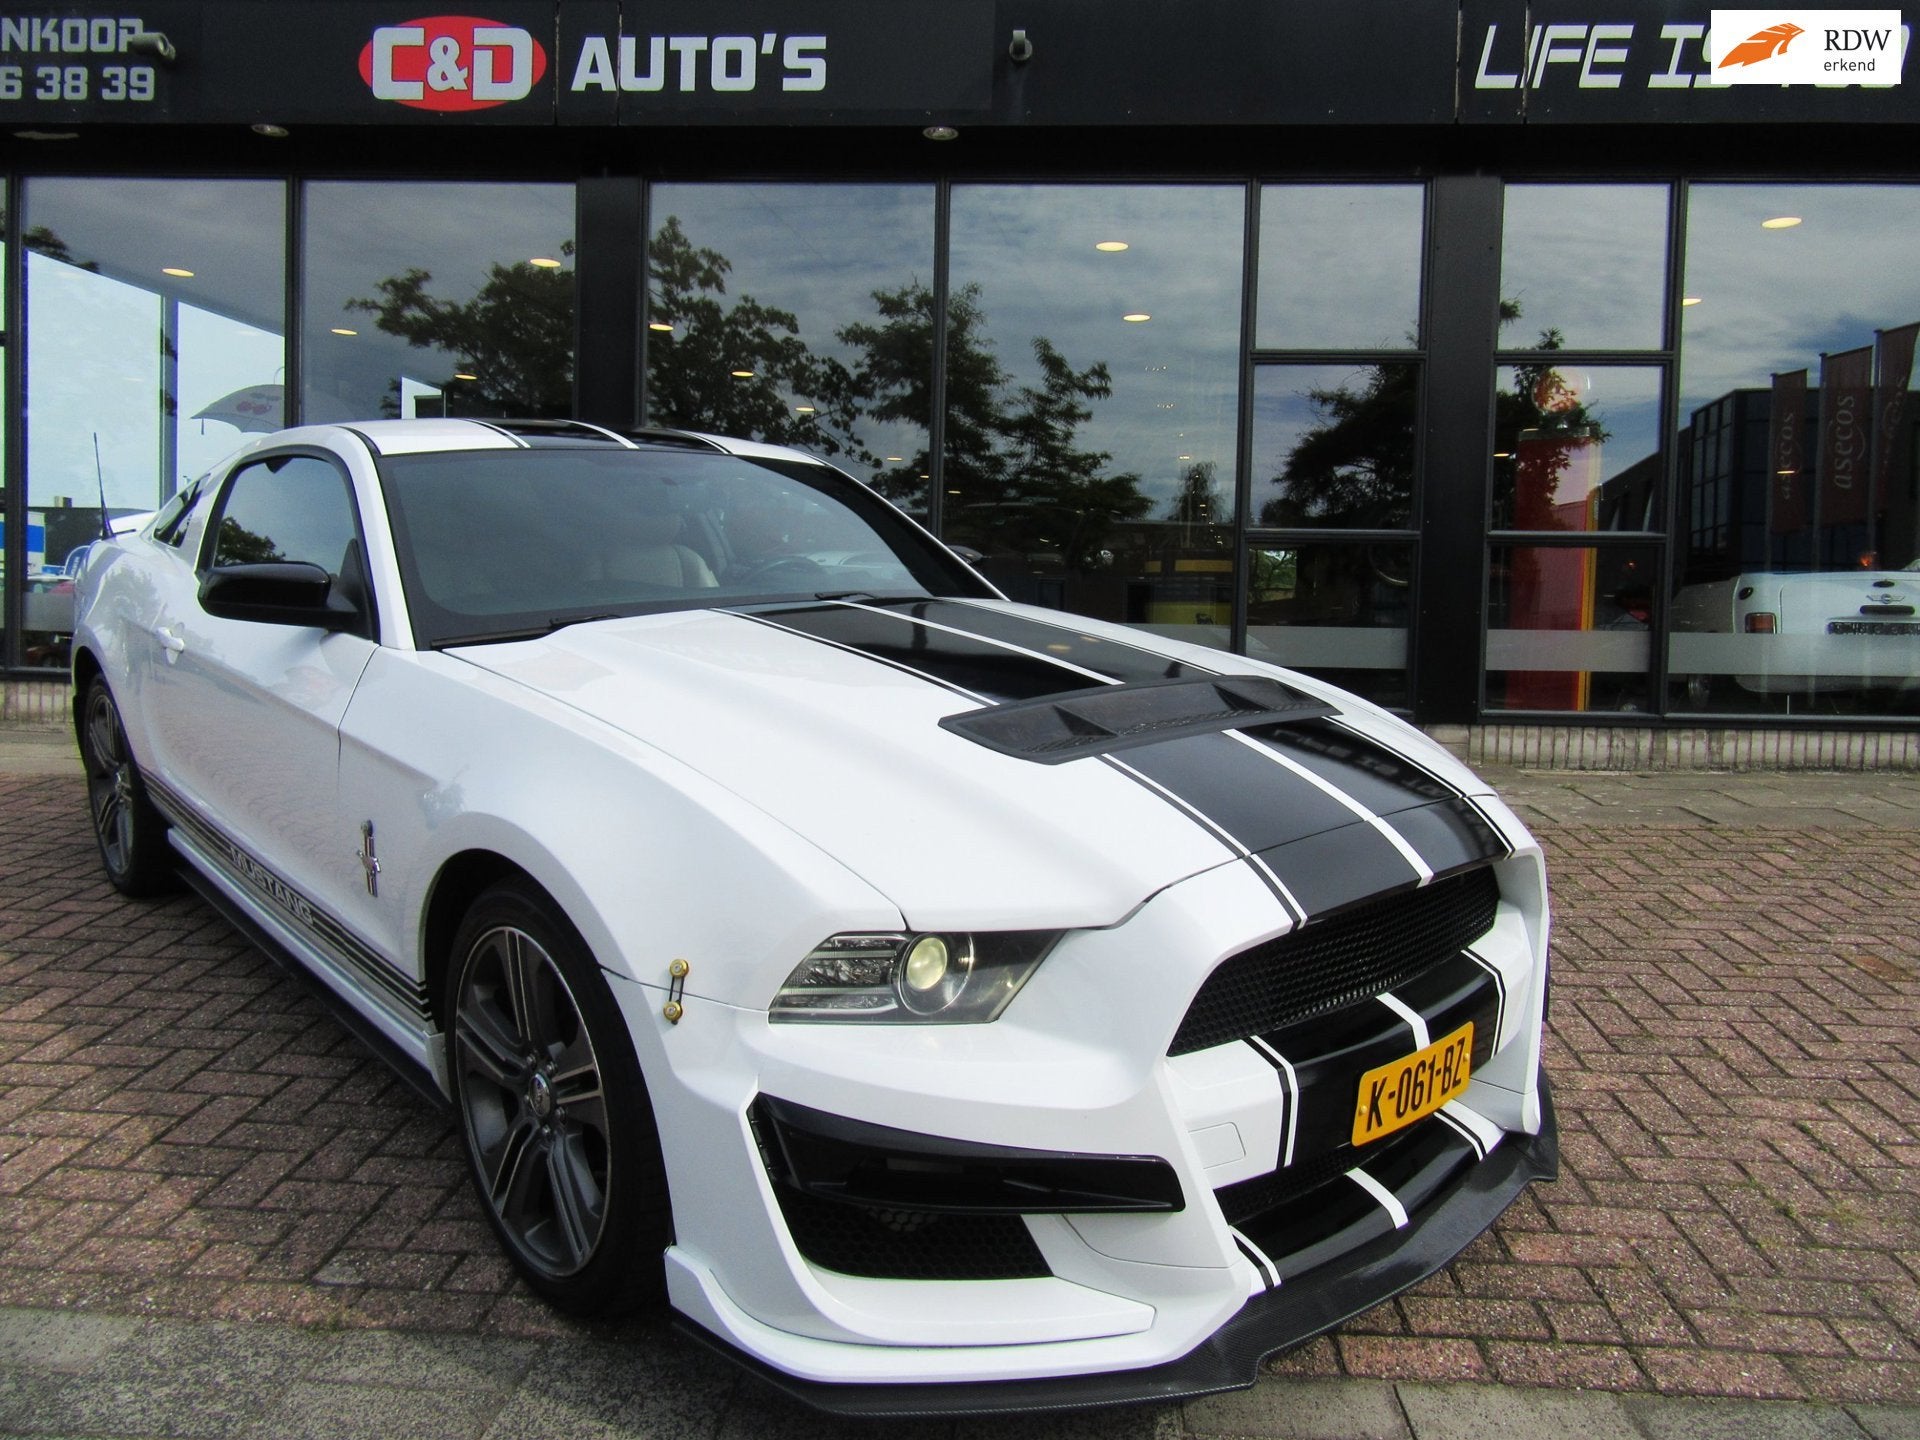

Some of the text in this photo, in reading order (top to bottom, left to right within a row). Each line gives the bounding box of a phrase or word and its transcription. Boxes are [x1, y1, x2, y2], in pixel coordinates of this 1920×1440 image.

[0, 66, 155, 100] 6 38 39
[372, 27, 533, 100] C&D
[570, 33, 827, 92] AUTO'S
[1475, 25, 1634, 89] LIFE
[1834, 396, 1855, 490] asecos
[230, 847, 314, 927] MUSTANG
[1366, 1036, 1466, 1134] K-061-BZ
